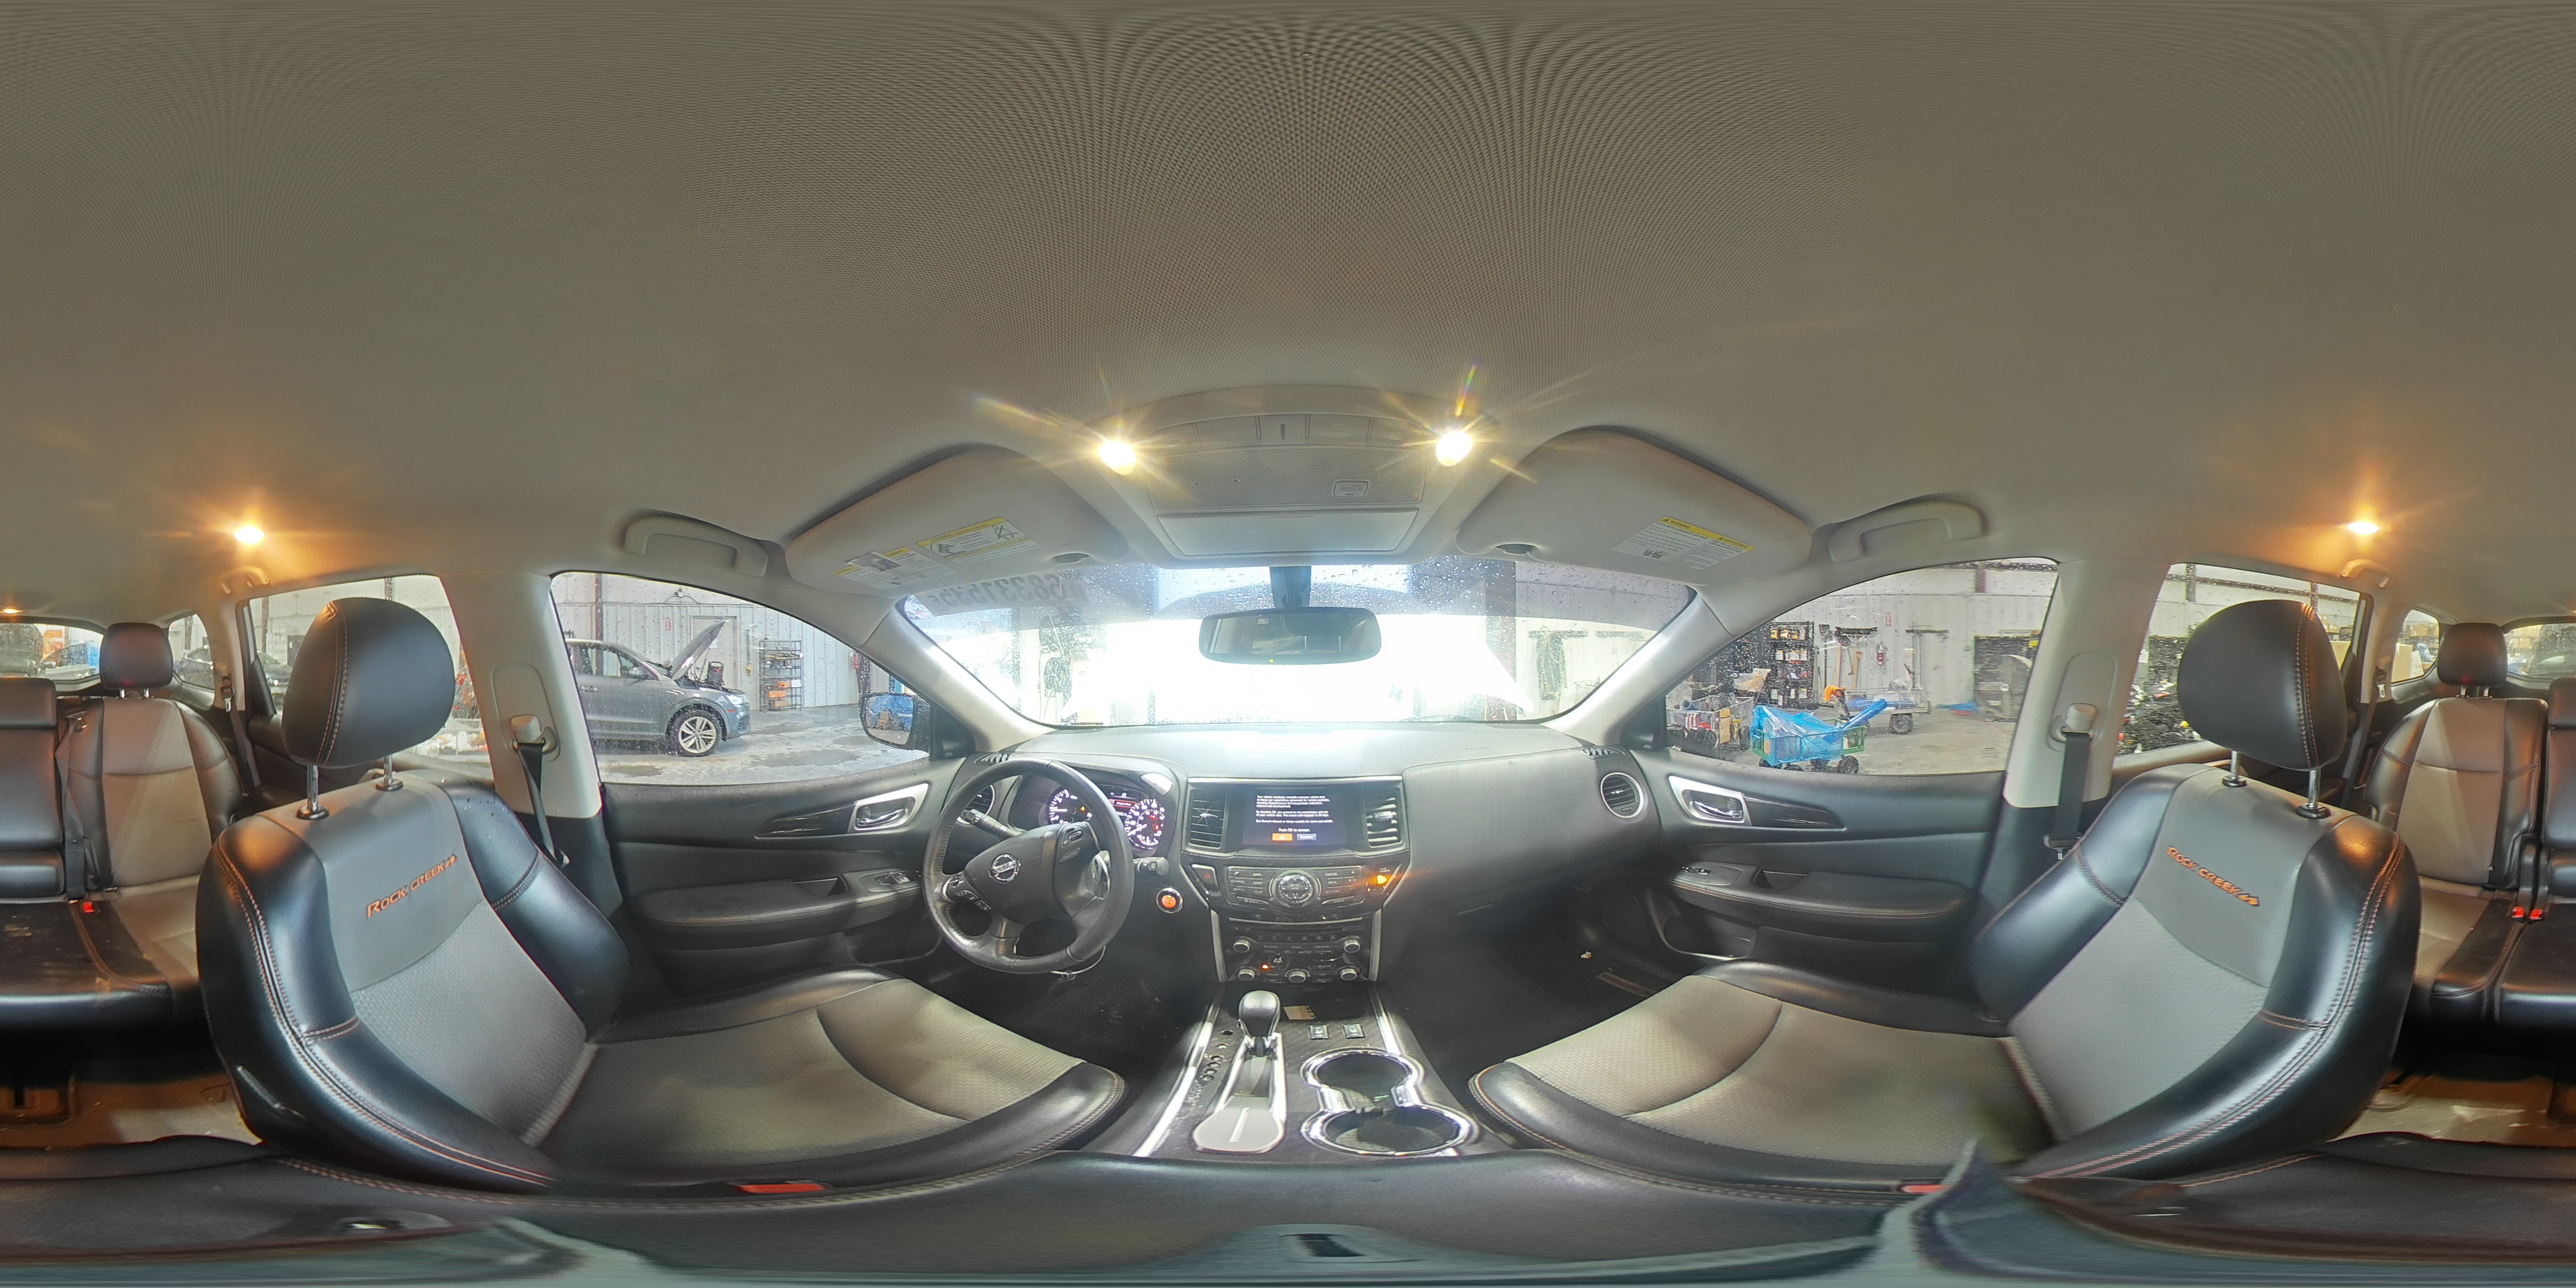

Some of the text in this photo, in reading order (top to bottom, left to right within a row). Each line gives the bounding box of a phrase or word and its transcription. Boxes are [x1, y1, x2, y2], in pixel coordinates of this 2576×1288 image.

[367, 859, 445, 918] ROCK CREEK
[991, 861, 1016, 873] NISSAN
[2166, 845, 2243, 896] ROCK CREEK
